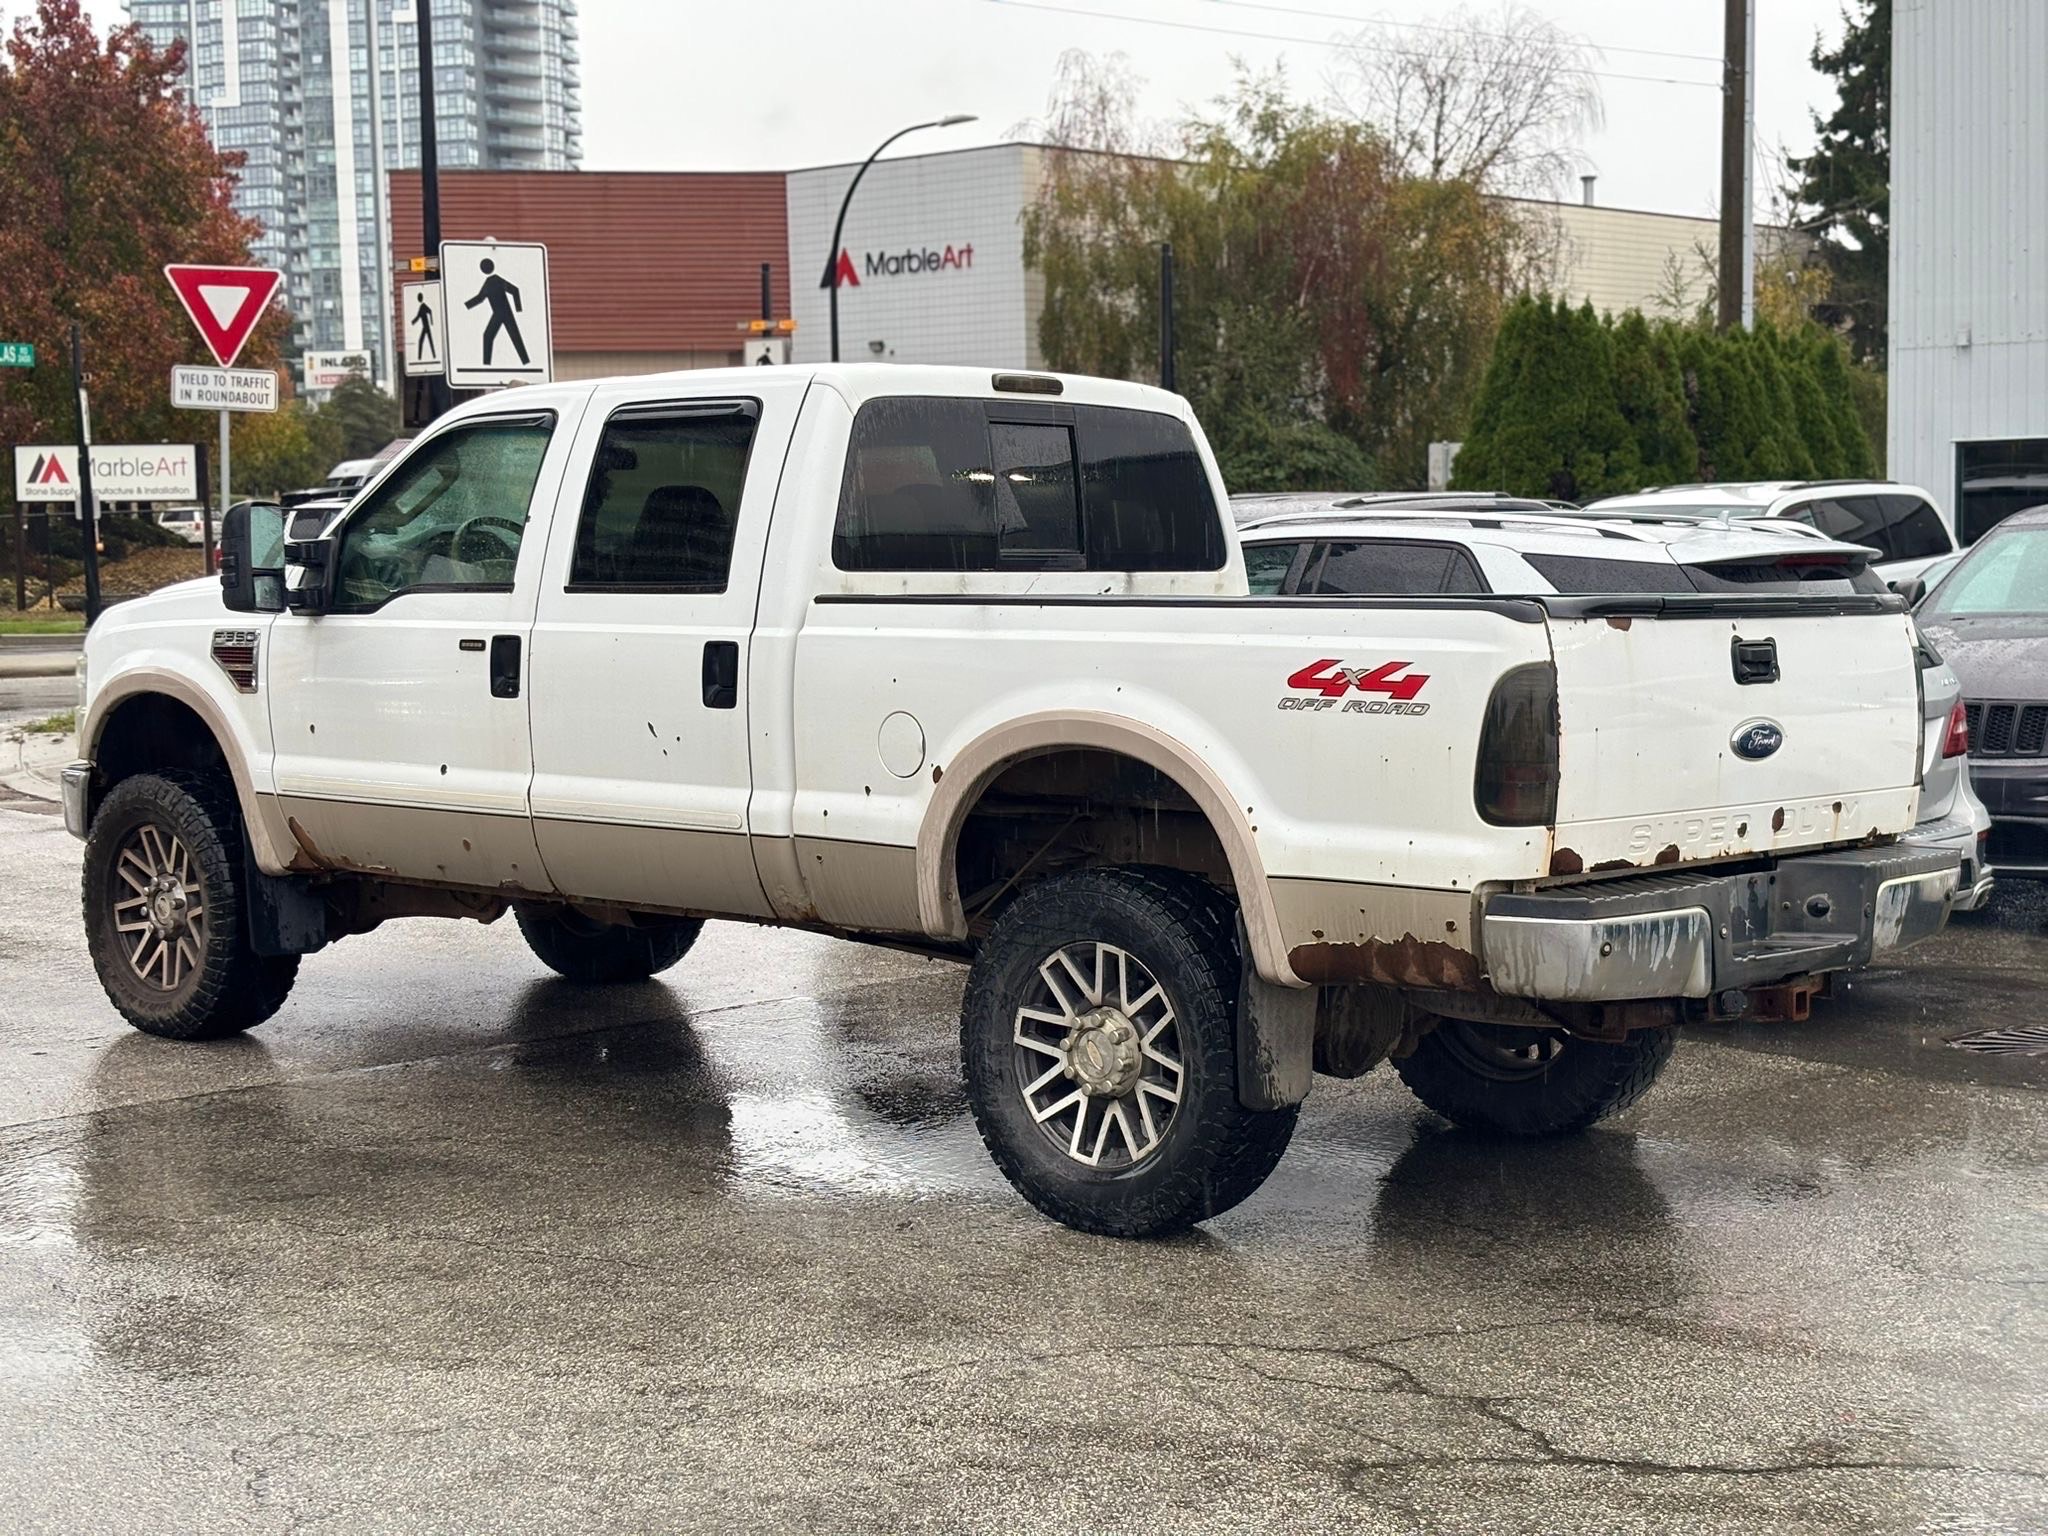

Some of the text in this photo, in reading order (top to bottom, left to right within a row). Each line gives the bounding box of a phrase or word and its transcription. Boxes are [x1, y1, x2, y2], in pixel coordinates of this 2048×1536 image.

[865, 243, 974, 277] MarbleArt
[180, 373, 271, 389] YIELD TO TRAFFIC
[180, 389, 270, 405] IN ROUNDABOUT
[25, 487, 49, 495] Stone
[92, 487, 134, 495] nufacture
[144, 486, 190, 495] Installation
[1278, 697, 1431, 716] OFF ROAD
[1747, 729, 1776, 750] Ford
[1629, 813, 1752, 856] SUPER
